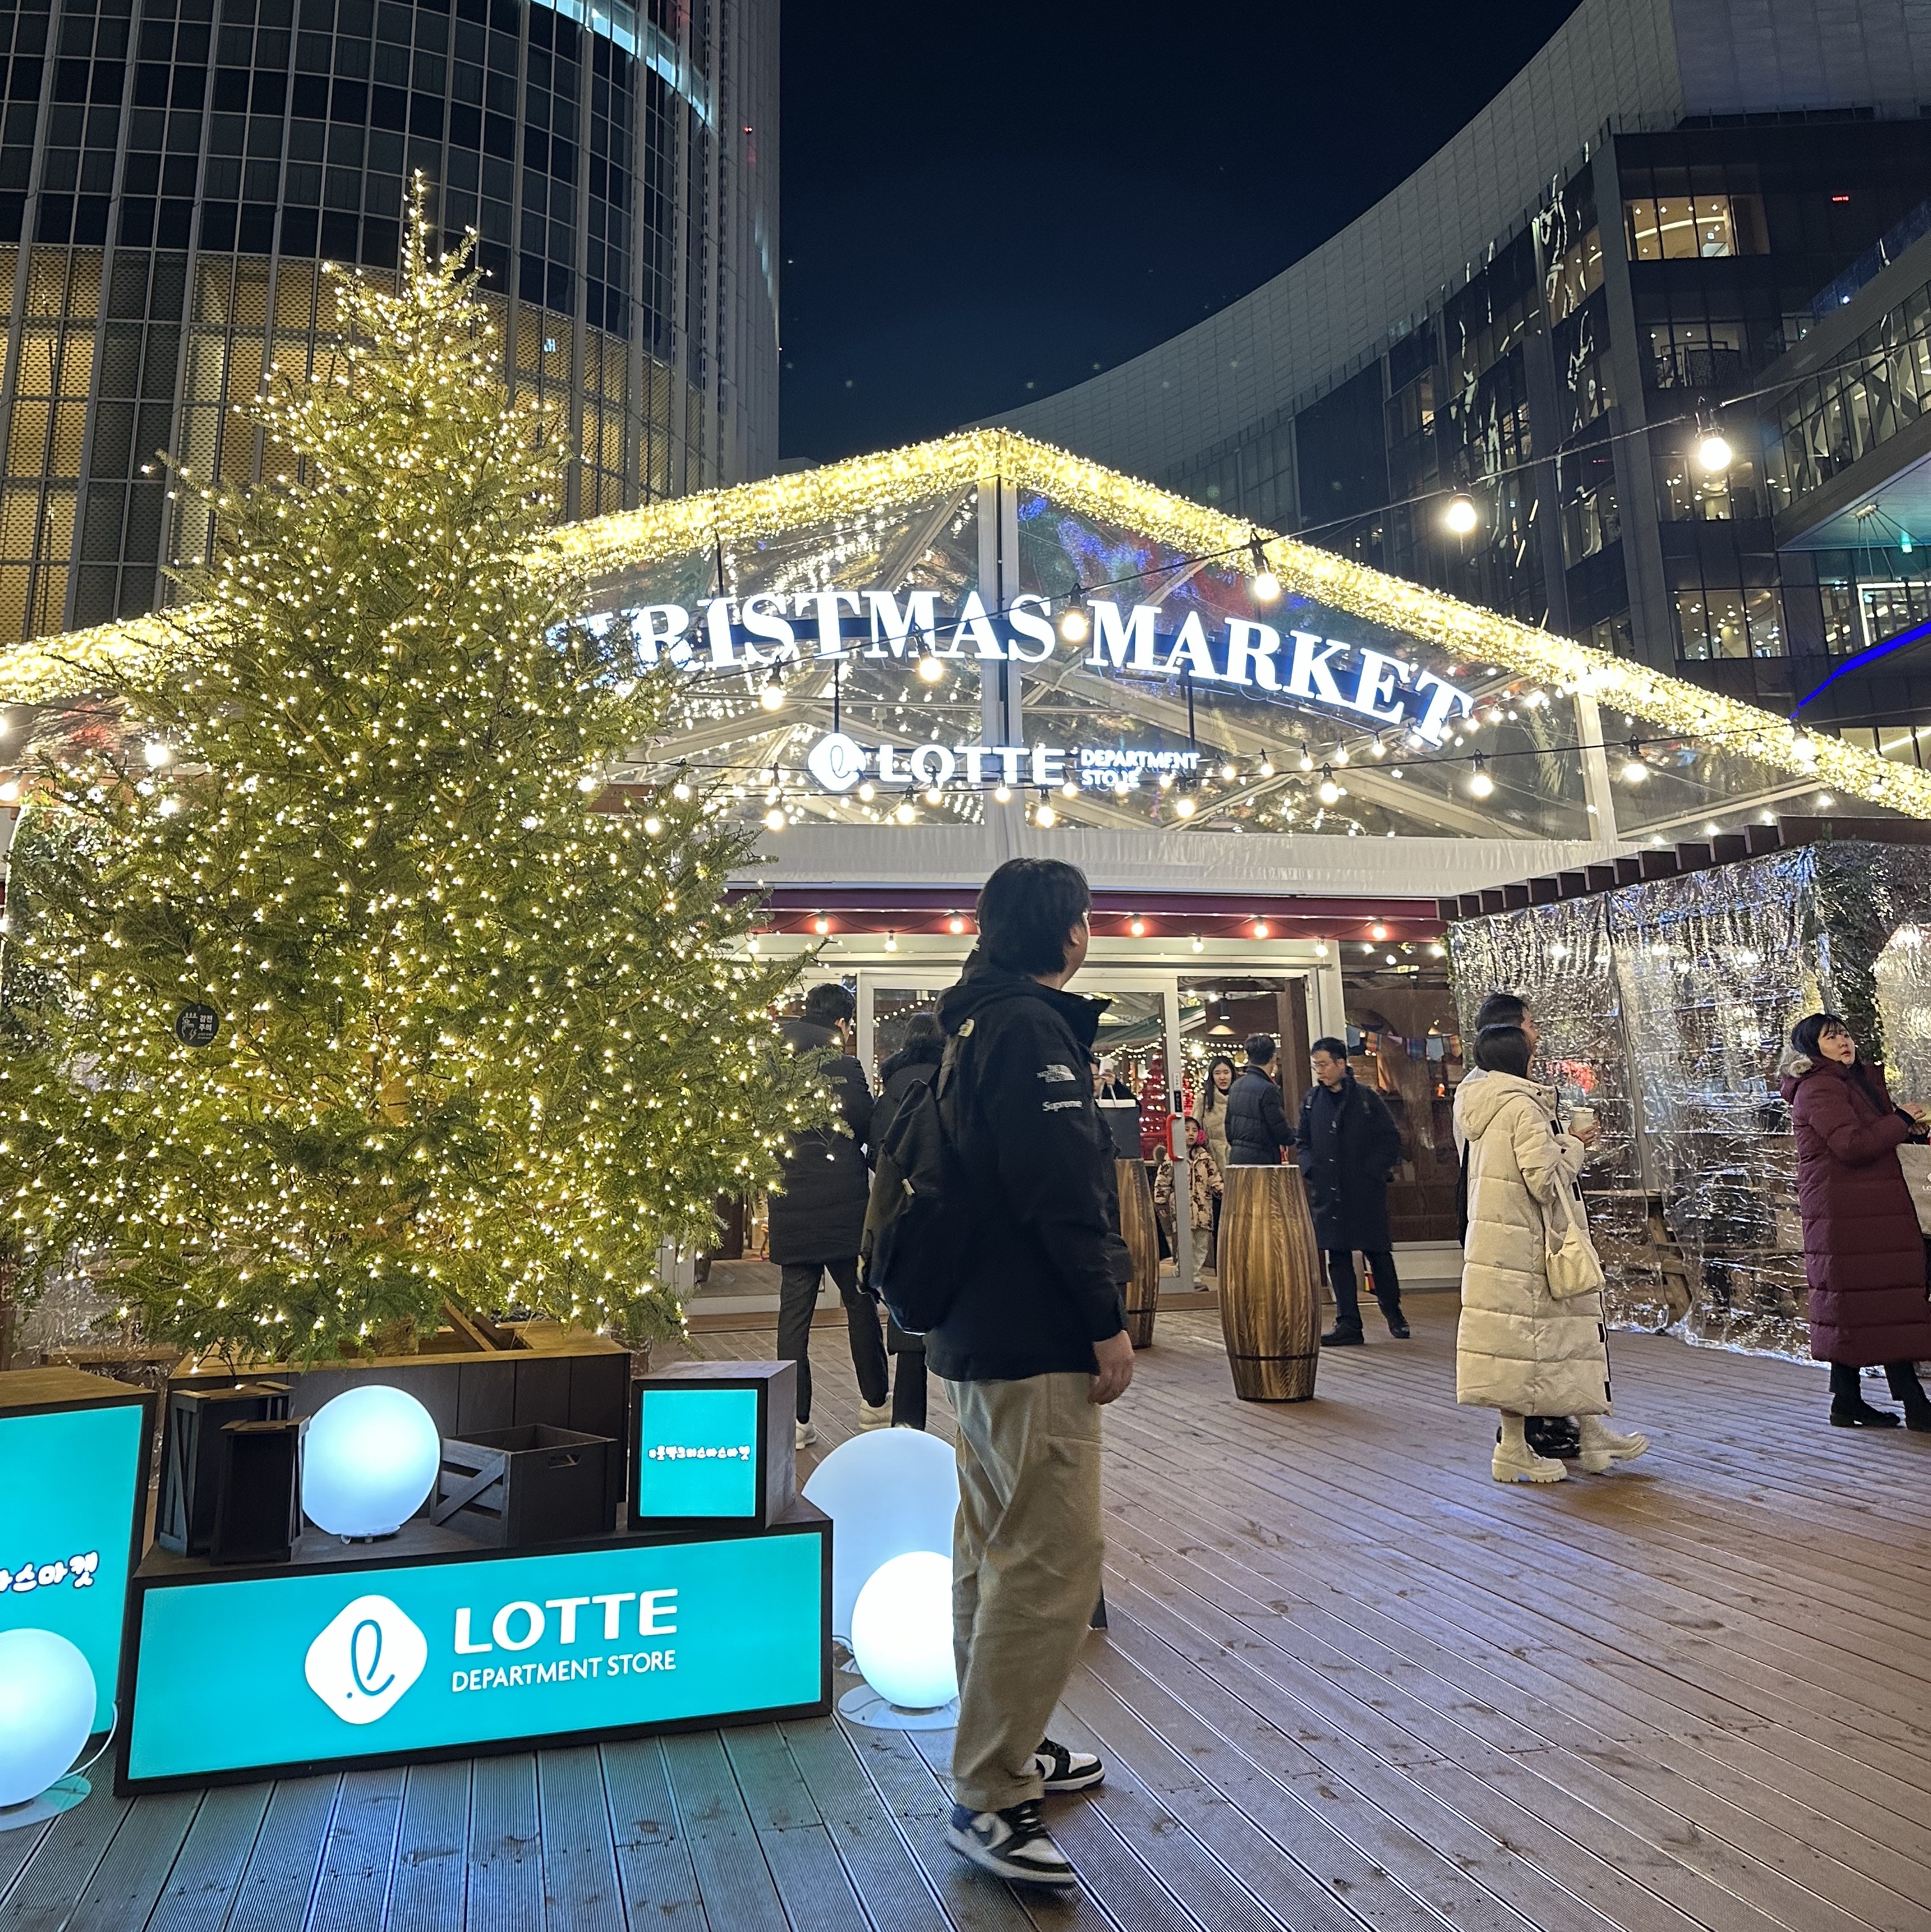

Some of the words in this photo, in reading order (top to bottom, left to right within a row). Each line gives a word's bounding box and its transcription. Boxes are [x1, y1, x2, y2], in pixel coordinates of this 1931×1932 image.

[545, 590, 1057, 677] RISTMAS
[1085, 599, 1474, 748] MARKET
[878, 743, 1066, 786] LOTTE
[1081, 749, 1201, 770] DEPARTMENT
[454, 1588, 678, 1655] LOTTE
[451, 1656, 604, 1692] DEPARTMENT
[606, 1649, 677, 1677] STORE
